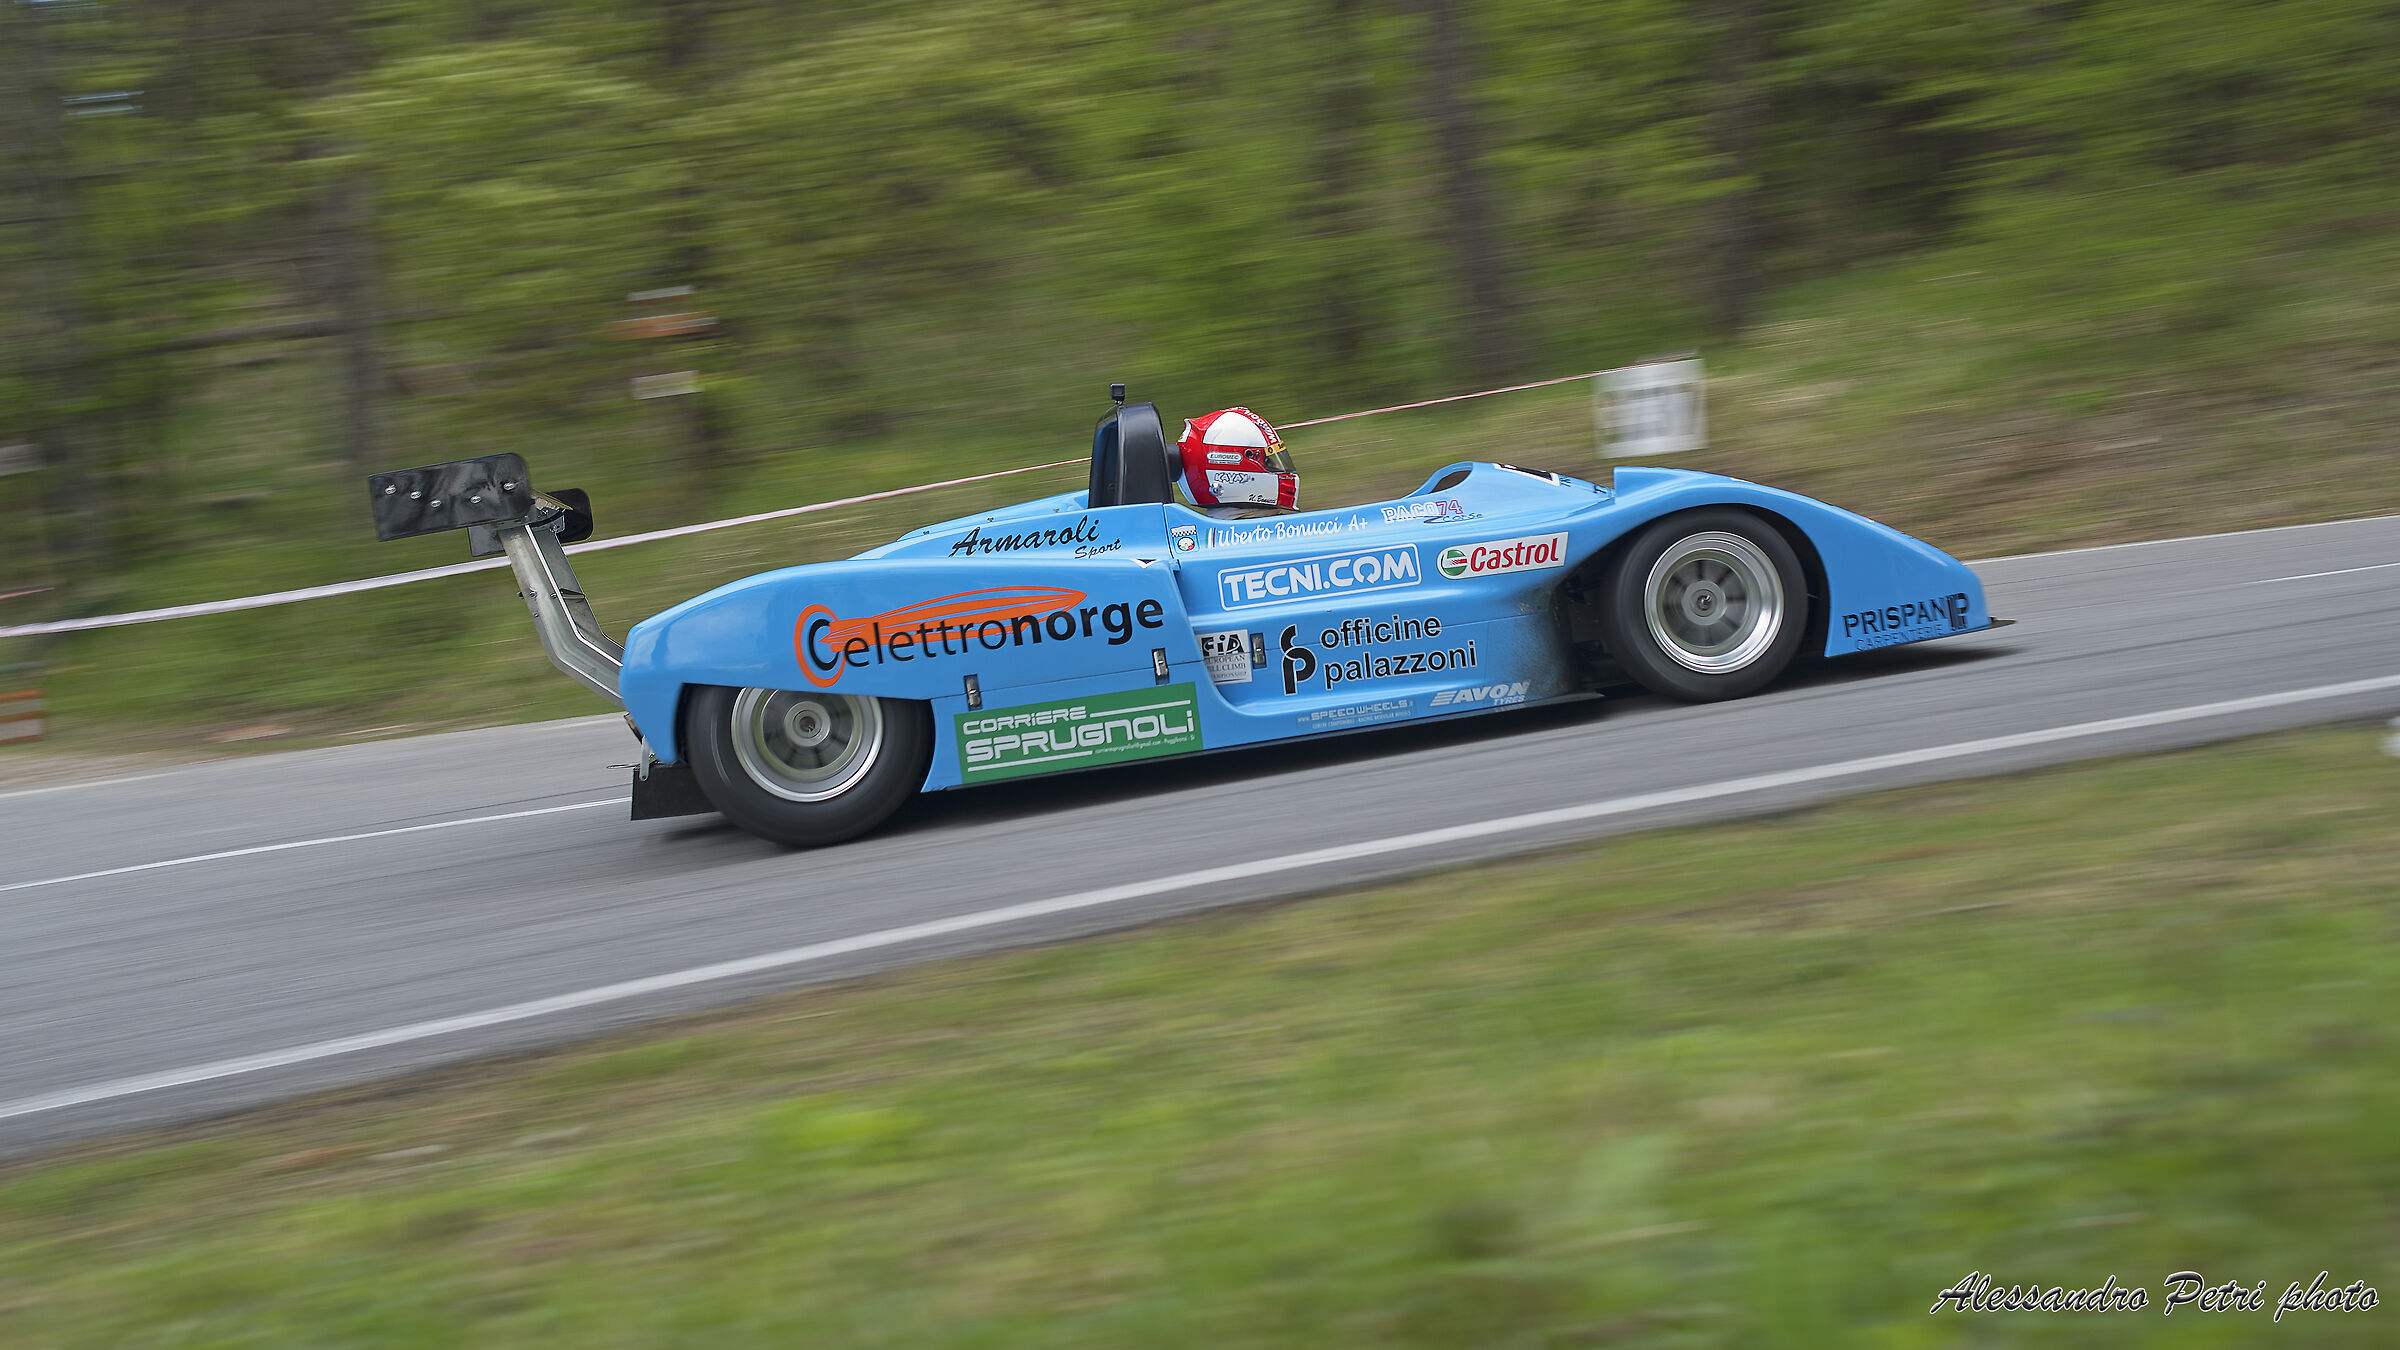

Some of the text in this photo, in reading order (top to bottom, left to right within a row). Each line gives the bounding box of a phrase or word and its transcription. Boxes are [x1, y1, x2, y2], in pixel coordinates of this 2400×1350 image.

[1214, 472, 1250, 484] KAYAK
[948, 514, 1100, 557] Armaroli
[1218, 526, 1274, 547] Uberto
[1275, 516, 1343, 540] Bonucci
[1074, 538, 1122, 559] Sport
[1470, 537, 1559, 573] Castrol
[1223, 551, 1417, 601] TECNI.COM
[1320, 614, 1442, 650] officine
[1323, 640, 1478, 690] palazzoni
[1452, 680, 1532, 704] AVON
[1494, 694, 1525, 705] TYRES
